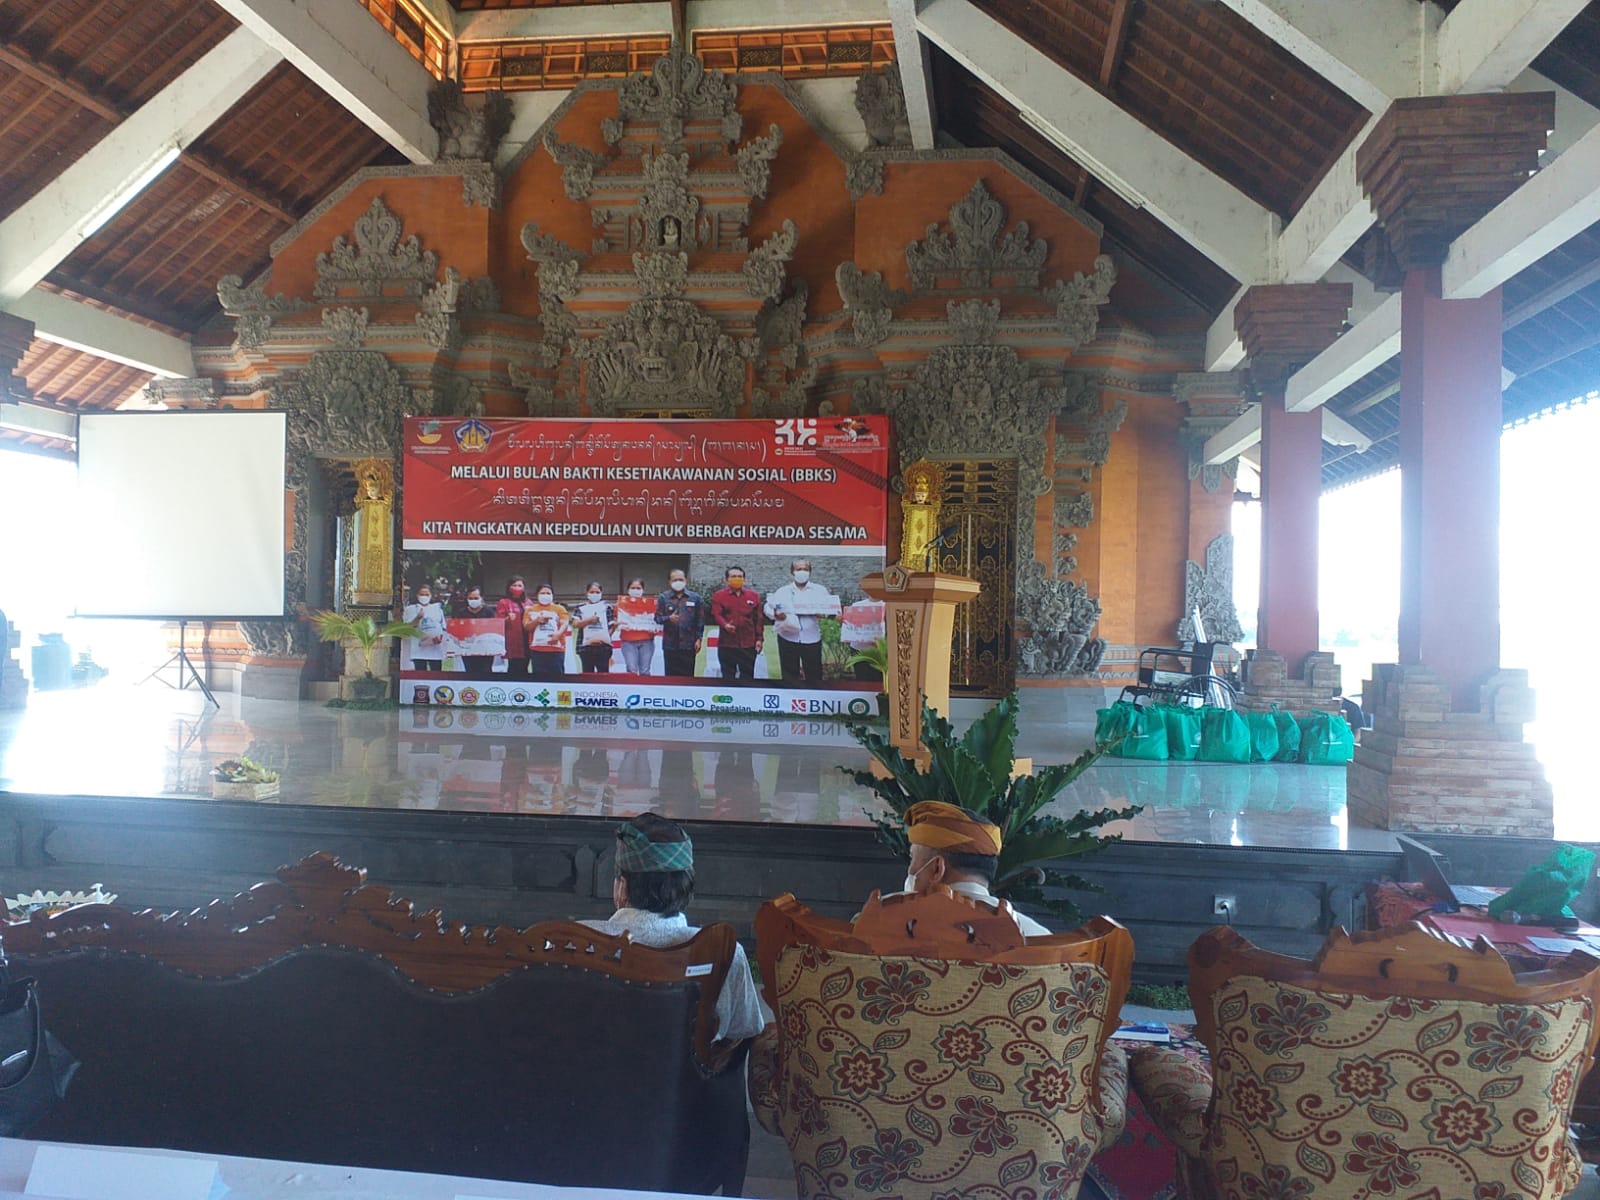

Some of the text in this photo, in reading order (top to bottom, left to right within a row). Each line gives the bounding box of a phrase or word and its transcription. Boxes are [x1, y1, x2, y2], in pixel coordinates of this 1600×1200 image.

[451, 465, 837, 483] MELALUI BULAN BAKTI KESETIAKAWANAN SOSIAL (BBKS)
[422, 521, 868, 540] KITA TINGKATKAN KEPEDULIAN UNTUK BERBAGI KEPADA SESAMA
[574, 697, 618, 707] POWER
[643, 697, 705, 709] PELINDO
[809, 699, 842, 714] BNI
